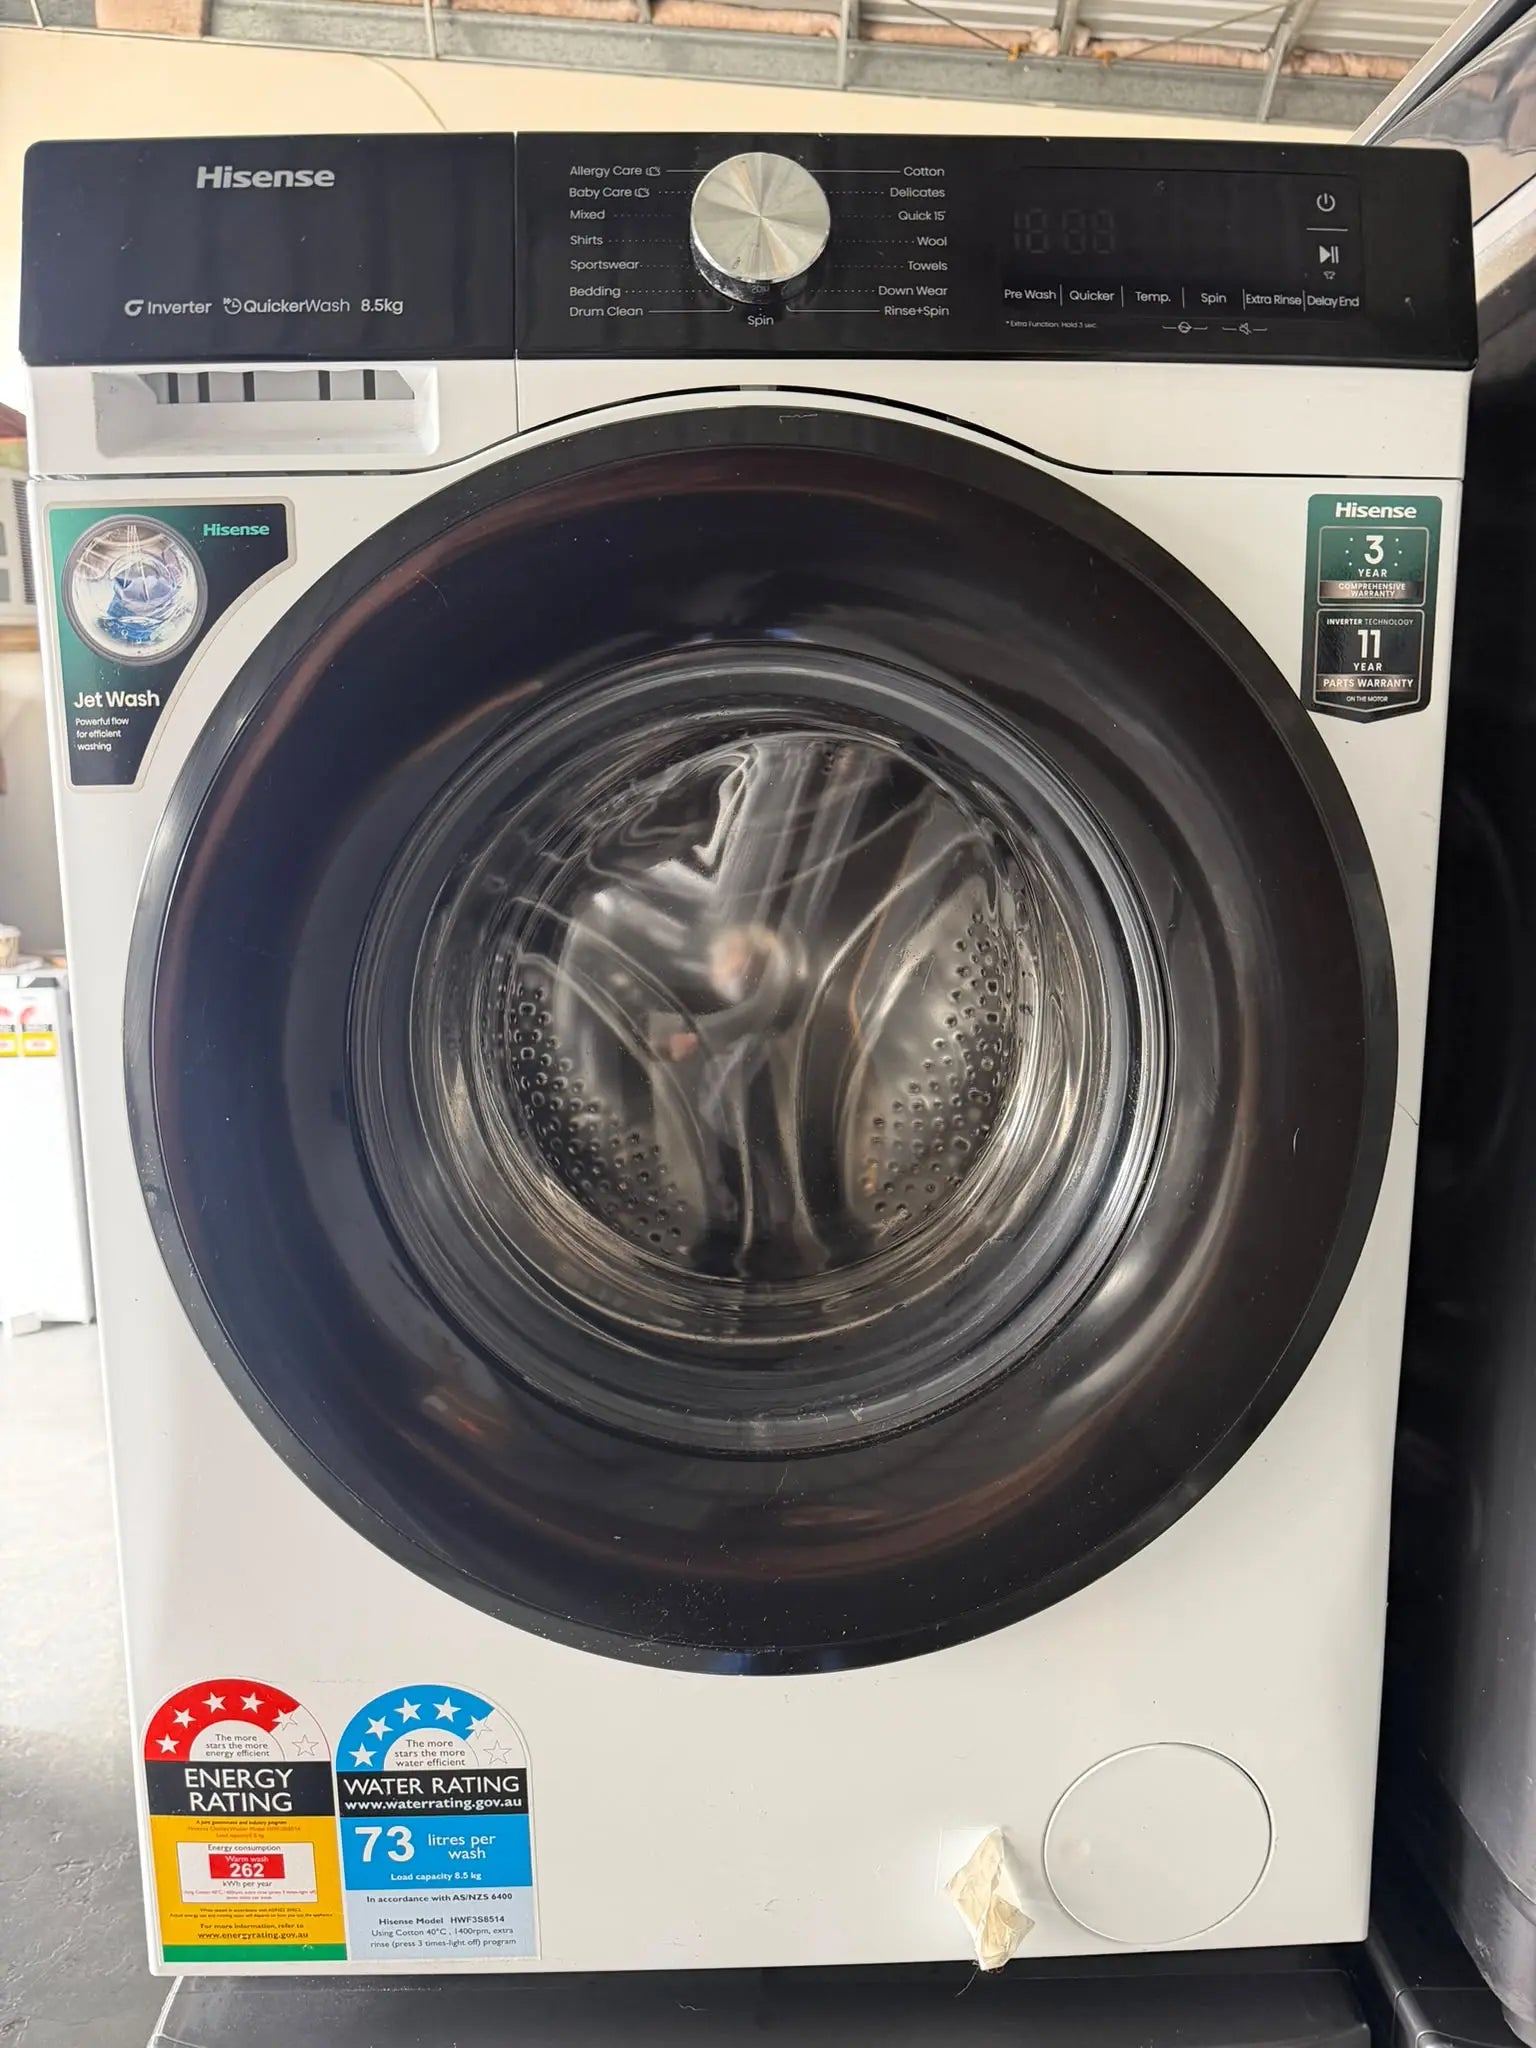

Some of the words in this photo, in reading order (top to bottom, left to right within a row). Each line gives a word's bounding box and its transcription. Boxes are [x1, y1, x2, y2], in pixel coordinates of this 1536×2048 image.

[196, 166, 335, 188] Hisense
[570, 166, 610, 178] Allergy
[613, 166, 642, 176] Care
[904, 166, 944, 177] Cotton
[569, 187, 600, 199] Baby
[603, 187, 632, 197] Care
[890, 187, 945, 198] Delicates
[570, 209, 605, 220] Mixed
[898, 211, 931, 221] Quick
[570, 235, 603, 245] Shirts
[917, 236, 948, 246] Wool
[570, 260, 640, 271] Sportswear
[908, 260, 948, 271] Towels
[570, 287, 621, 298] Bedding
[878, 286, 913, 296] Down
[916, 286, 948, 296] Wear
[1004, 289, 1022, 299] Pre
[1024, 289, 1057, 300] Wash
[1069, 290, 1115, 301] Quicker
[1136, 291, 1171, 303] Temp.
[1201, 293, 1227, 305] Spin
[1246, 294, 1271, 304] Extra
[1274, 294, 1302, 305] Rinse
[1307, 295, 1338, 308] Delay
[1339, 296, 1360, 307] End
[148, 300, 212, 314] Inverter
[244, 298, 350, 314] QuickerWash
[360, 298, 404, 315] 8.5kg
[570, 307, 604, 317] Drum
[607, 307, 643, 316] Clean
[884, 305, 949, 317] Rinse+Spin
[747, 315, 774, 327] Spin
[1335, 502, 1417, 519] Hisense
[203, 524, 270, 536] Hisense
[1364, 535, 1384, 565] 3
[1358, 568, 1388, 578] YEAR
[1338, 583, 1406, 591] COMPREHENSIVE
[1351, 590, 1396, 598] WARRANTY
[1357, 629, 1381, 658] 11
[1353, 662, 1382, 672] YEAR
[1323, 679, 1354, 688] PARTS
[1357, 679, 1414, 688] WARRANTY
[73, 692, 103, 709] Jet
[106, 690, 160, 707] Wash
[75, 717, 110, 726] Powerful
[111, 716, 129, 726] flow
[76, 730, 88, 738] for
[88, 729, 122, 738] efficient
[77, 742, 112, 752] washing
[215, 1733, 232, 1742] The
[206, 1750, 234, 1758] energy
[236, 1749, 270, 1757] efficient
[395, 1750, 418, 1758] stars
[421, 1749, 437, 1757] the
[185, 1768, 294, 1789] ENERGY
[343, 1778, 424, 1795] WATER
[432, 1776, 520, 1794] RATING
[189, 1792, 292, 1813] RATING
[345, 1797, 522, 1811] www.waterrating.gov.au
[354, 1825, 415, 1863] 73
[428, 1833, 465, 1846] litres
[471, 1835, 496, 1848] per
[208, 1844, 232, 1852] Energy
[234, 1844, 281, 1852] consumption
[448, 1847, 487, 1860] wash
[229, 1863, 265, 1877] 262
[390, 1873, 413, 1881] Load
[415, 1873, 452, 1882] capacity
[471, 1872, 482, 1881] kg
[378, 1895, 429, 1903] accordance
[431, 1894, 451, 1902] with
[452, 1893, 489, 1901] AS/NZS
[416, 1917, 444, 1925] Model
[450, 1916, 505, 1924] HWF3S8514
[371, 1929, 394, 1938] Using
[454, 1928, 491, 1936] 1400rpm,
[392, 1940, 416, 1948] (press
[425, 1938, 466, 1947] times-light
[468, 1938, 481, 1947] off)
[483, 1938, 516, 1947] program
